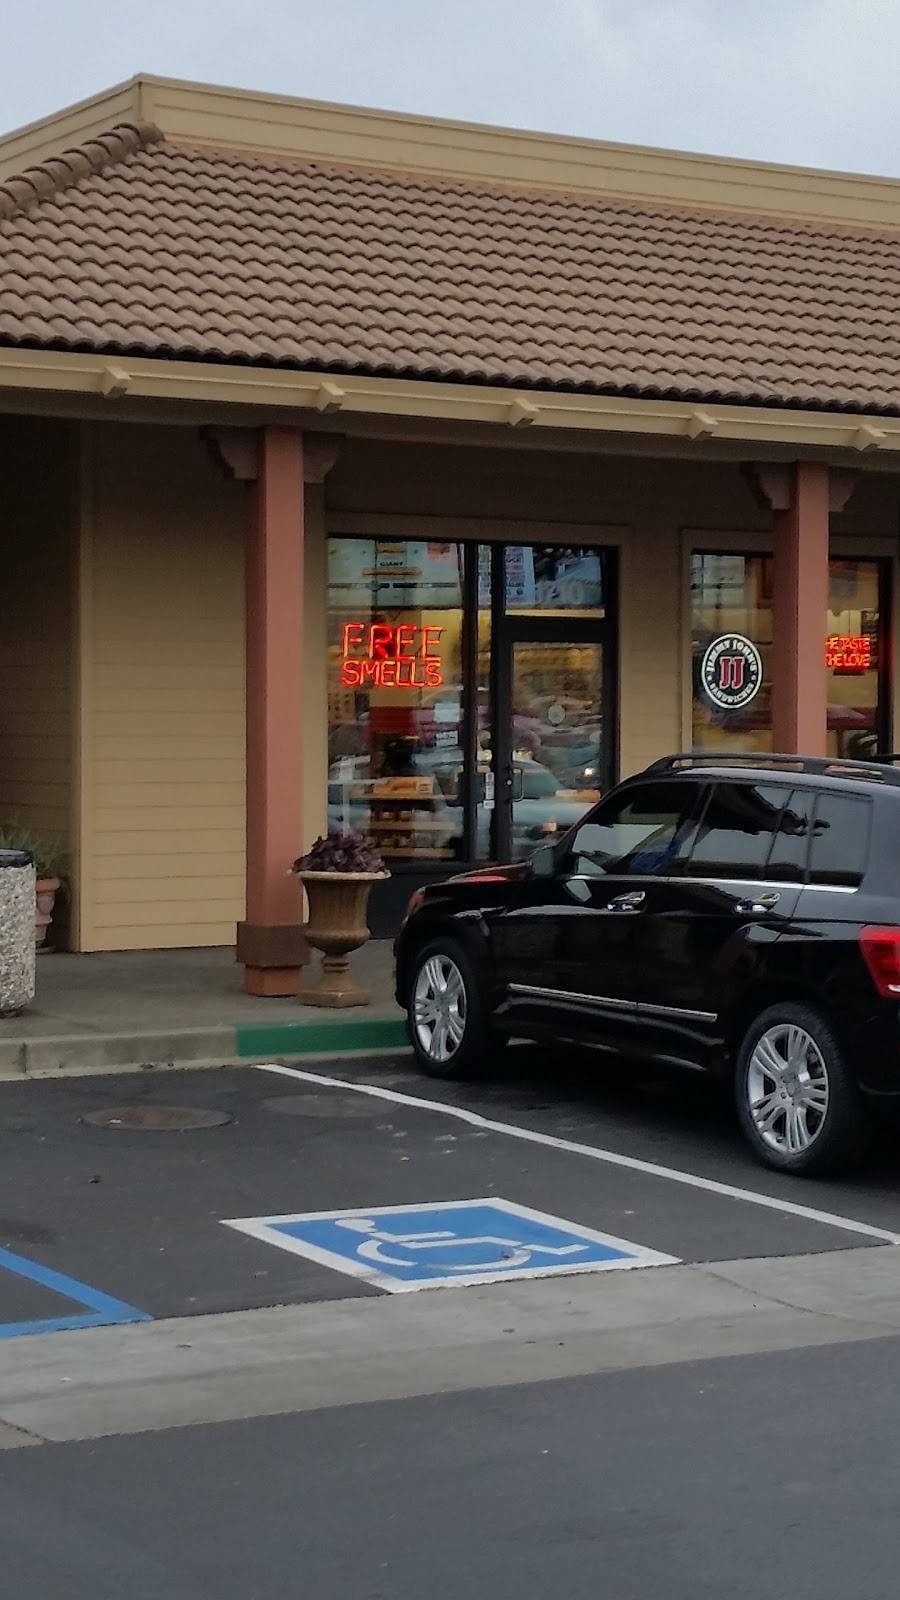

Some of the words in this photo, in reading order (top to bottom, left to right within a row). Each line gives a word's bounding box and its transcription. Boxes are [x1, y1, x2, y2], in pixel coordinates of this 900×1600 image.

[343, 623, 443, 660] FREE
[706, 640, 730, 672] JIMMY
[839, 637, 870, 651] TASTE
[341, 660, 444, 687] SMELLS
[719, 656, 745, 690] JJ
[843, 653, 870, 667] LOVE
